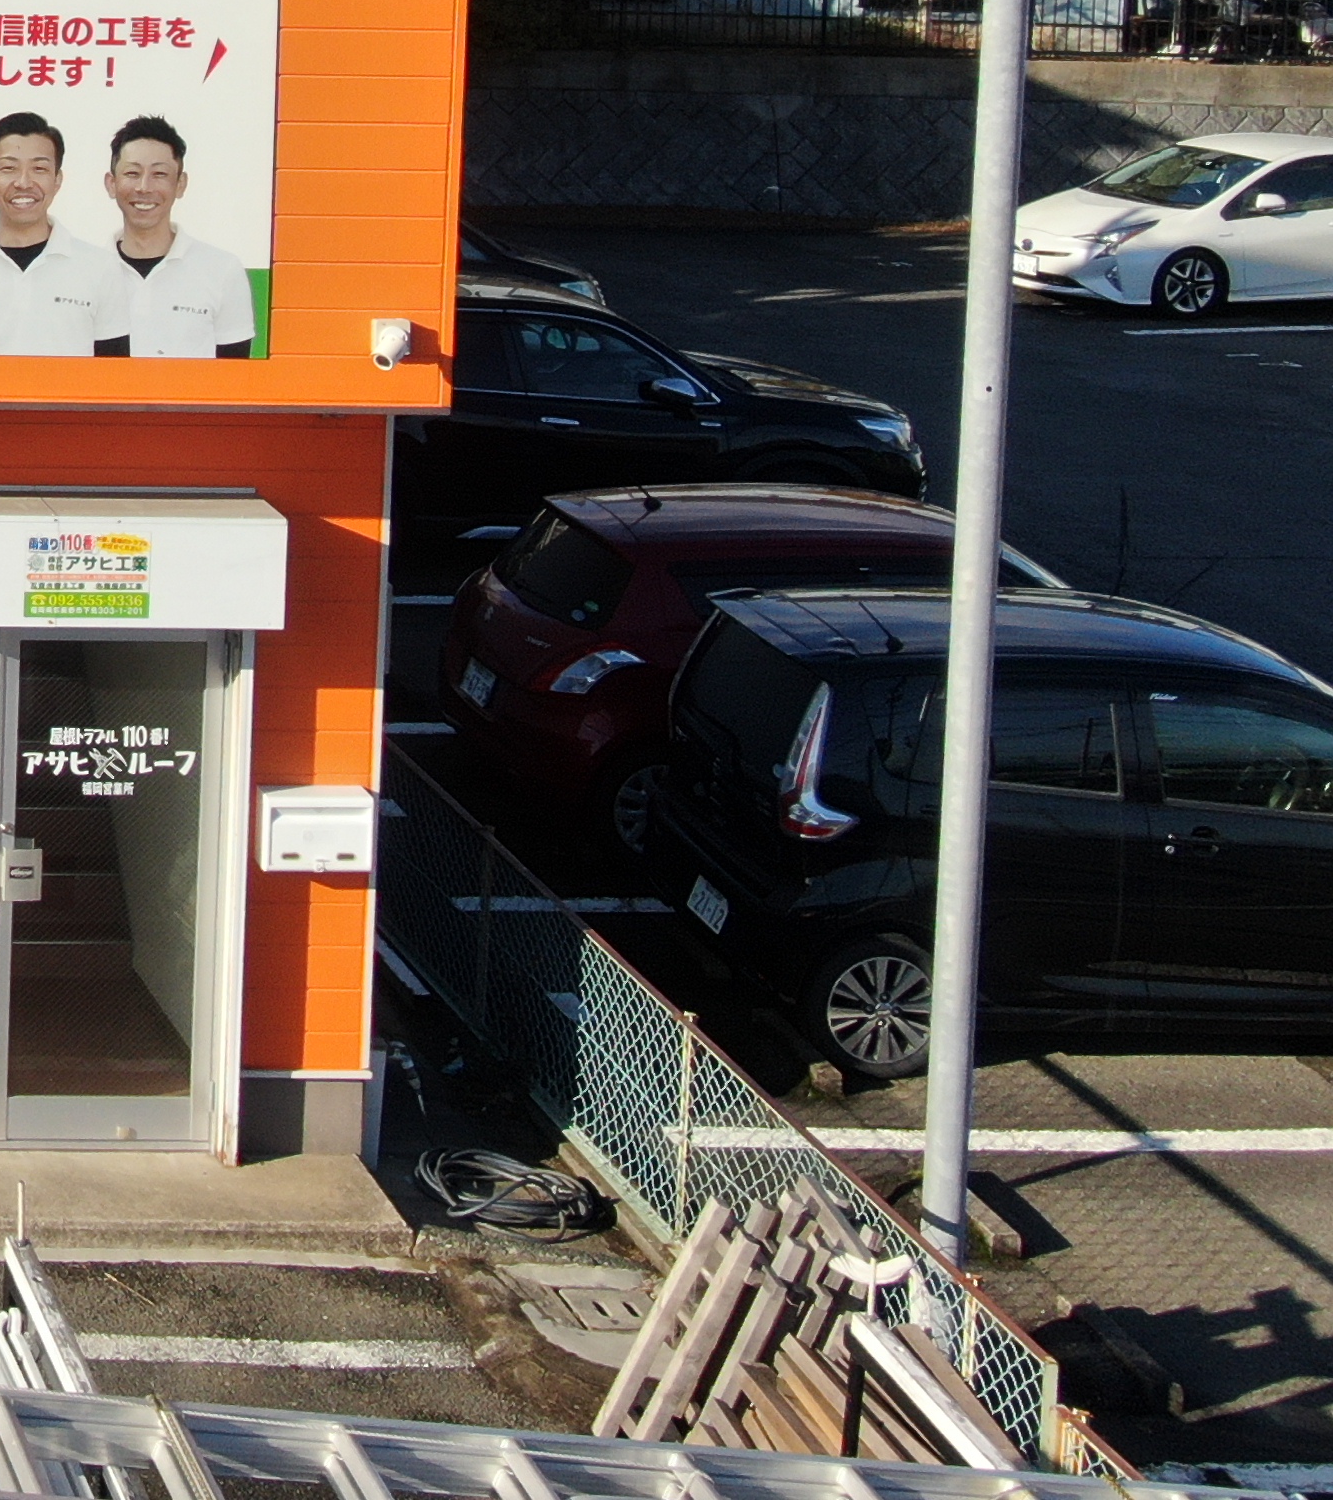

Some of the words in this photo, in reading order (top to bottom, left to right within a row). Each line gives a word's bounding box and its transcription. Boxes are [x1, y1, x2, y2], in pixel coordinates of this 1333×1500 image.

[66, 556, 148, 572] アサヒ工業
